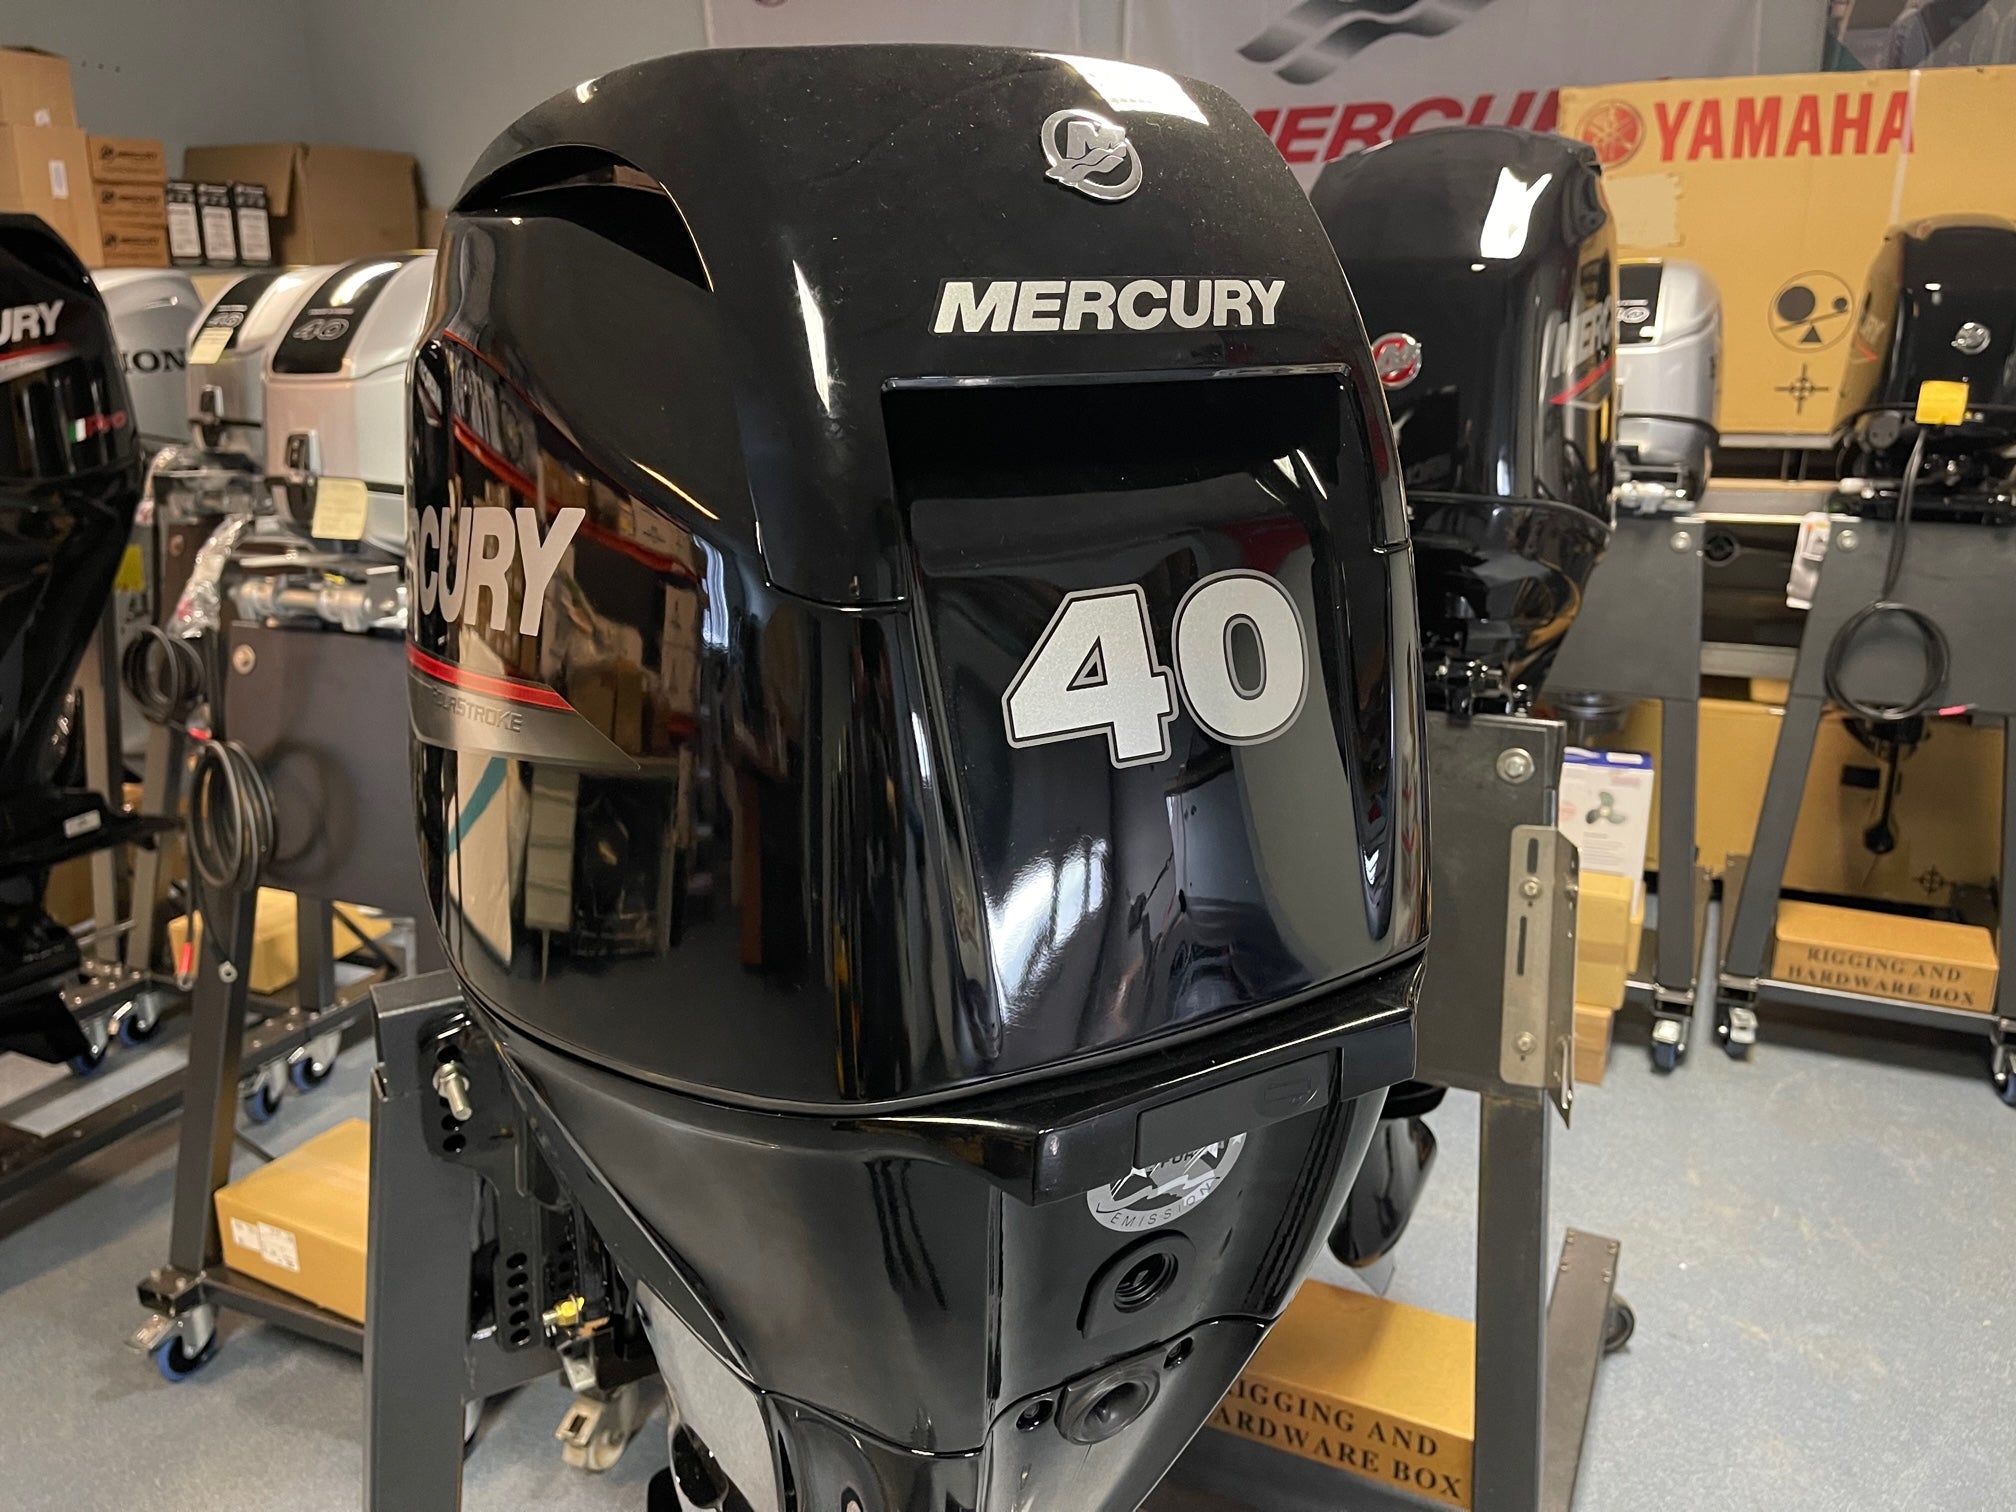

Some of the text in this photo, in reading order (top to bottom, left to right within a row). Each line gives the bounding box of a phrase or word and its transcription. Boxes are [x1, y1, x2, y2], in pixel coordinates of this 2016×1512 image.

[1654, 91, 1915, 162] YAMAHA
[933, 279, 1286, 333] MERCURY
[293, 317, 350, 341] 40
[1001, 568, 1310, 769] 40
[1807, 948, 1961, 983] RIGGING AND
[1788, 966, 1975, 1007] HARDWARE BOX
[1368, 1421, 1438, 1457] AND
[1393, 1459, 1462, 1499] BOX
